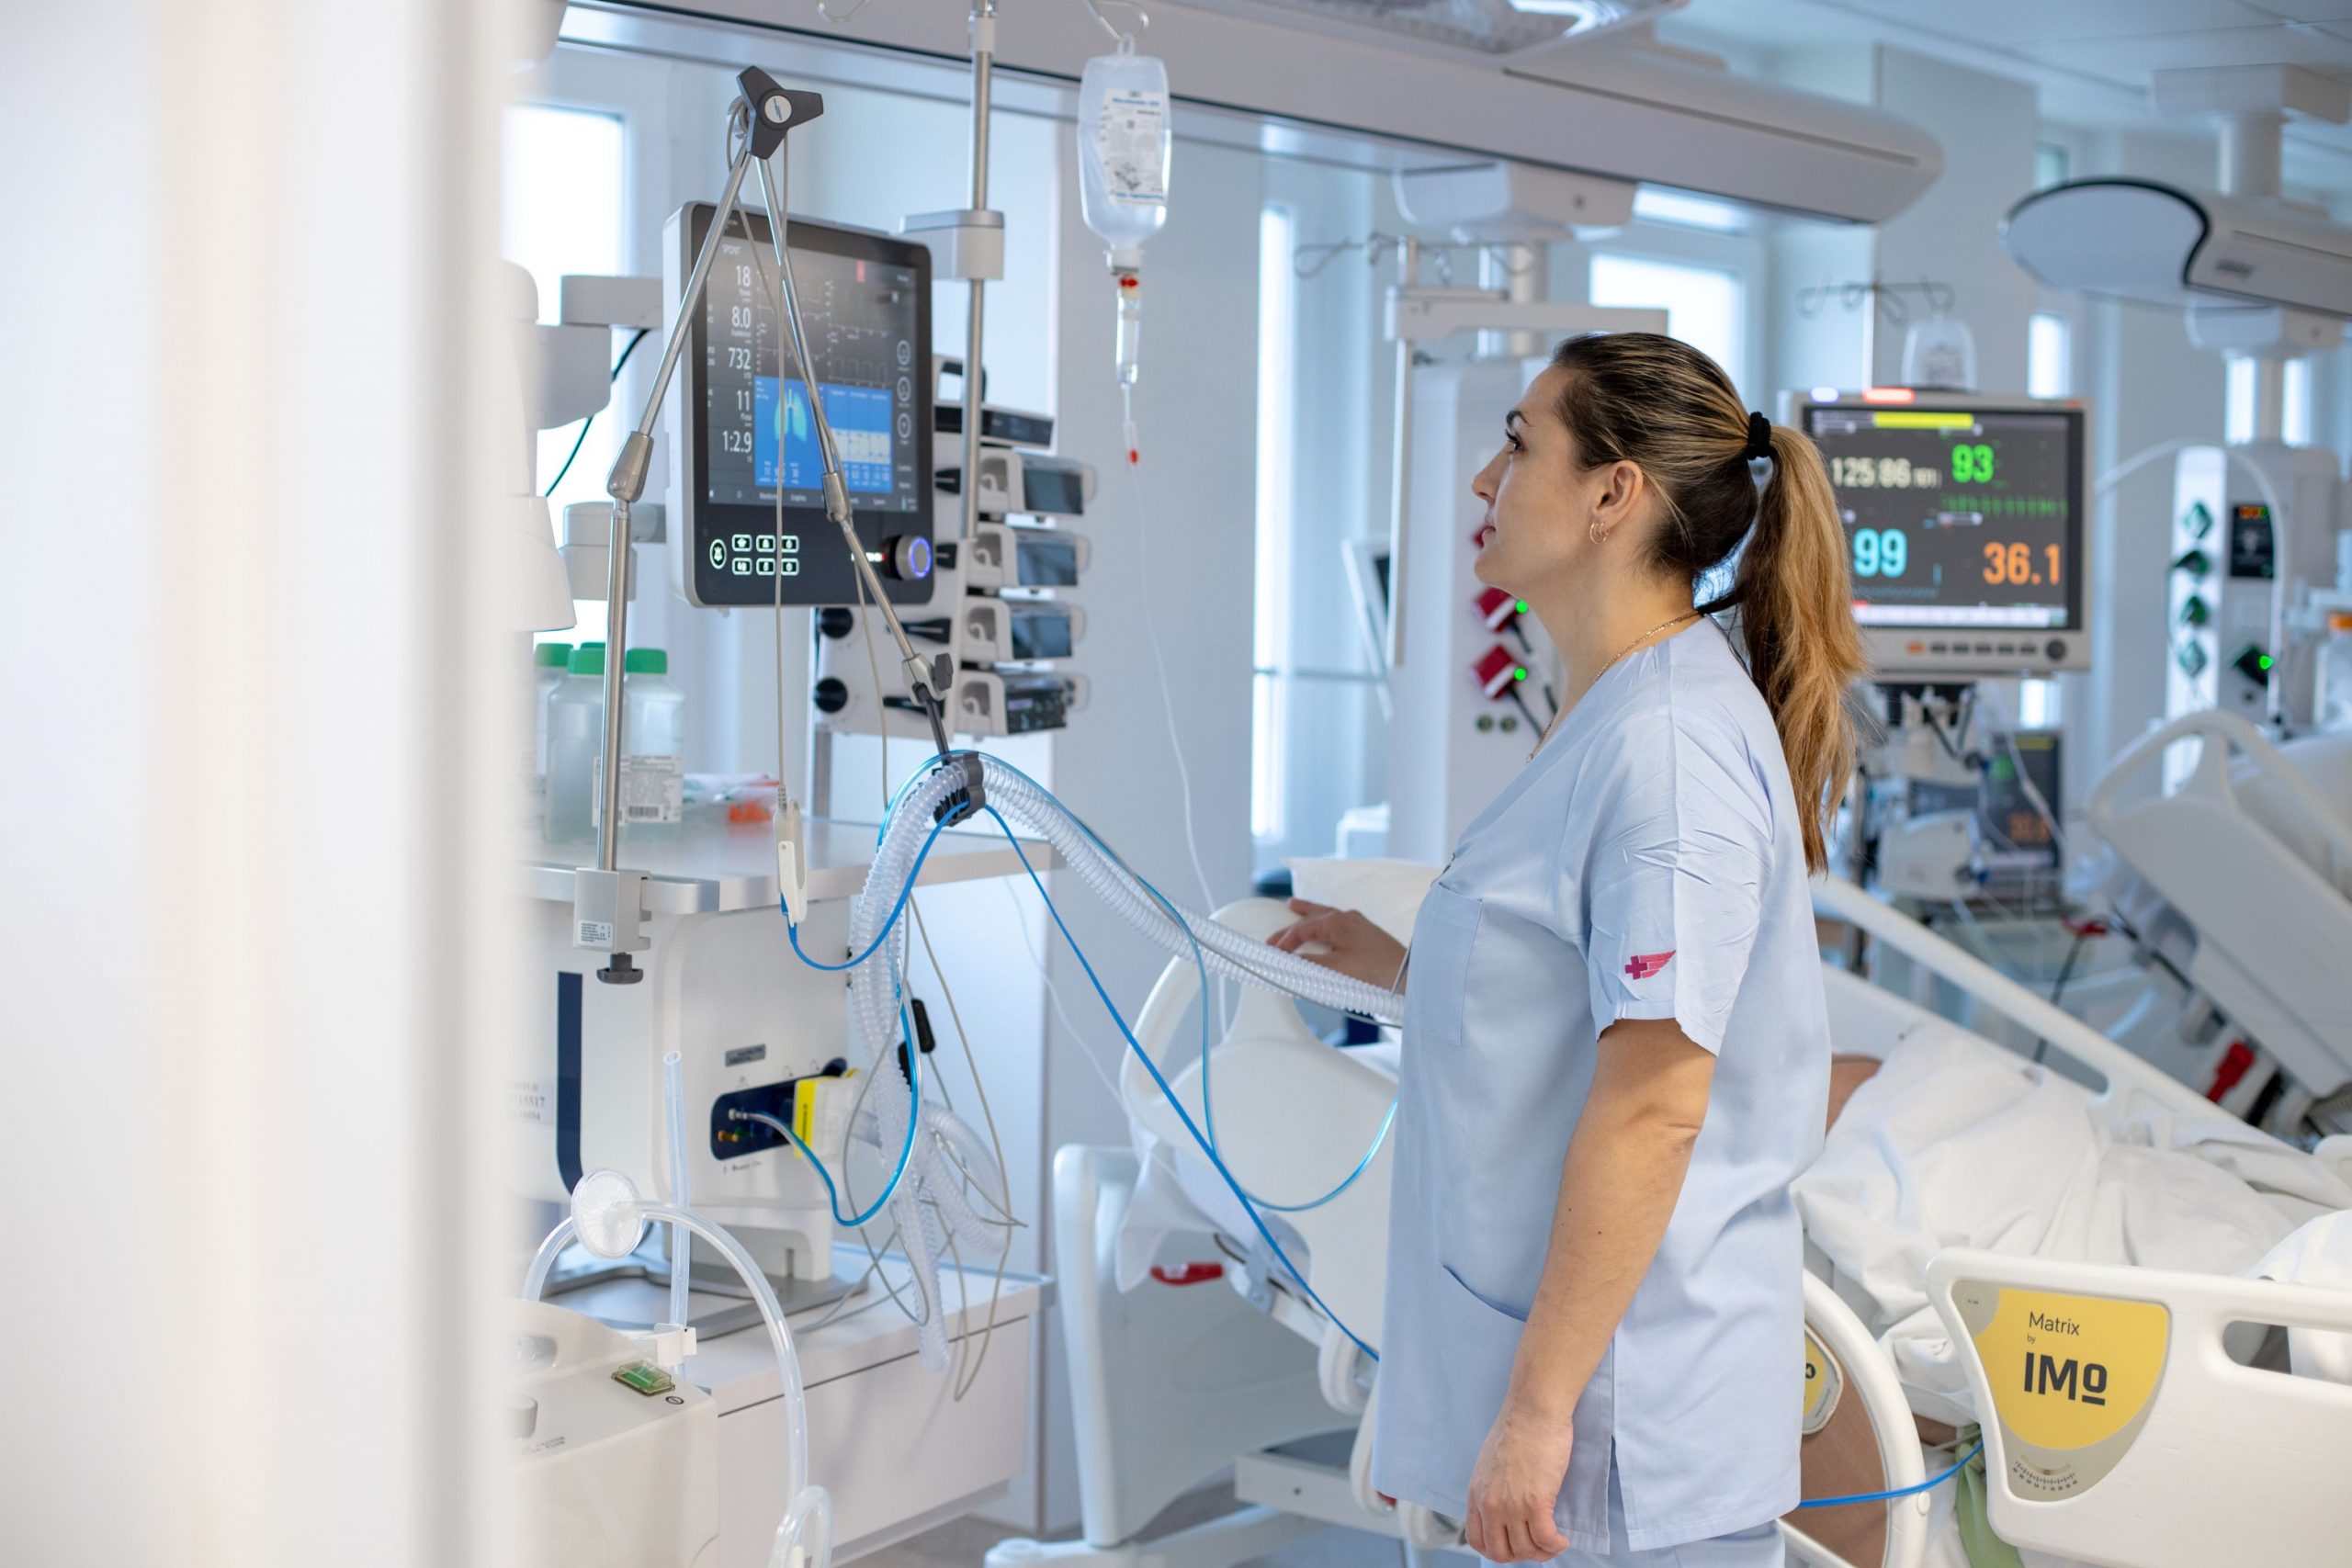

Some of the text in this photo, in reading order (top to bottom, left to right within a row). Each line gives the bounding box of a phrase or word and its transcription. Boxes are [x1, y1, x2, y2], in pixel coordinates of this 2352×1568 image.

[736, 265, 752, 287] 18
[731, 306, 752, 328] 8.0
[728, 347, 752, 369] 732
[737, 389, 751, 412] 11
[722, 430, 752, 453] 1:2.9
[1951, 444, 1995, 484] 93
[1853, 528, 1907, 579] 99
[1983, 541, 2061, 585] 36.1
[2028, 1311, 2080, 1337] Matrix
[2027, 1333, 2036, 1345] by
